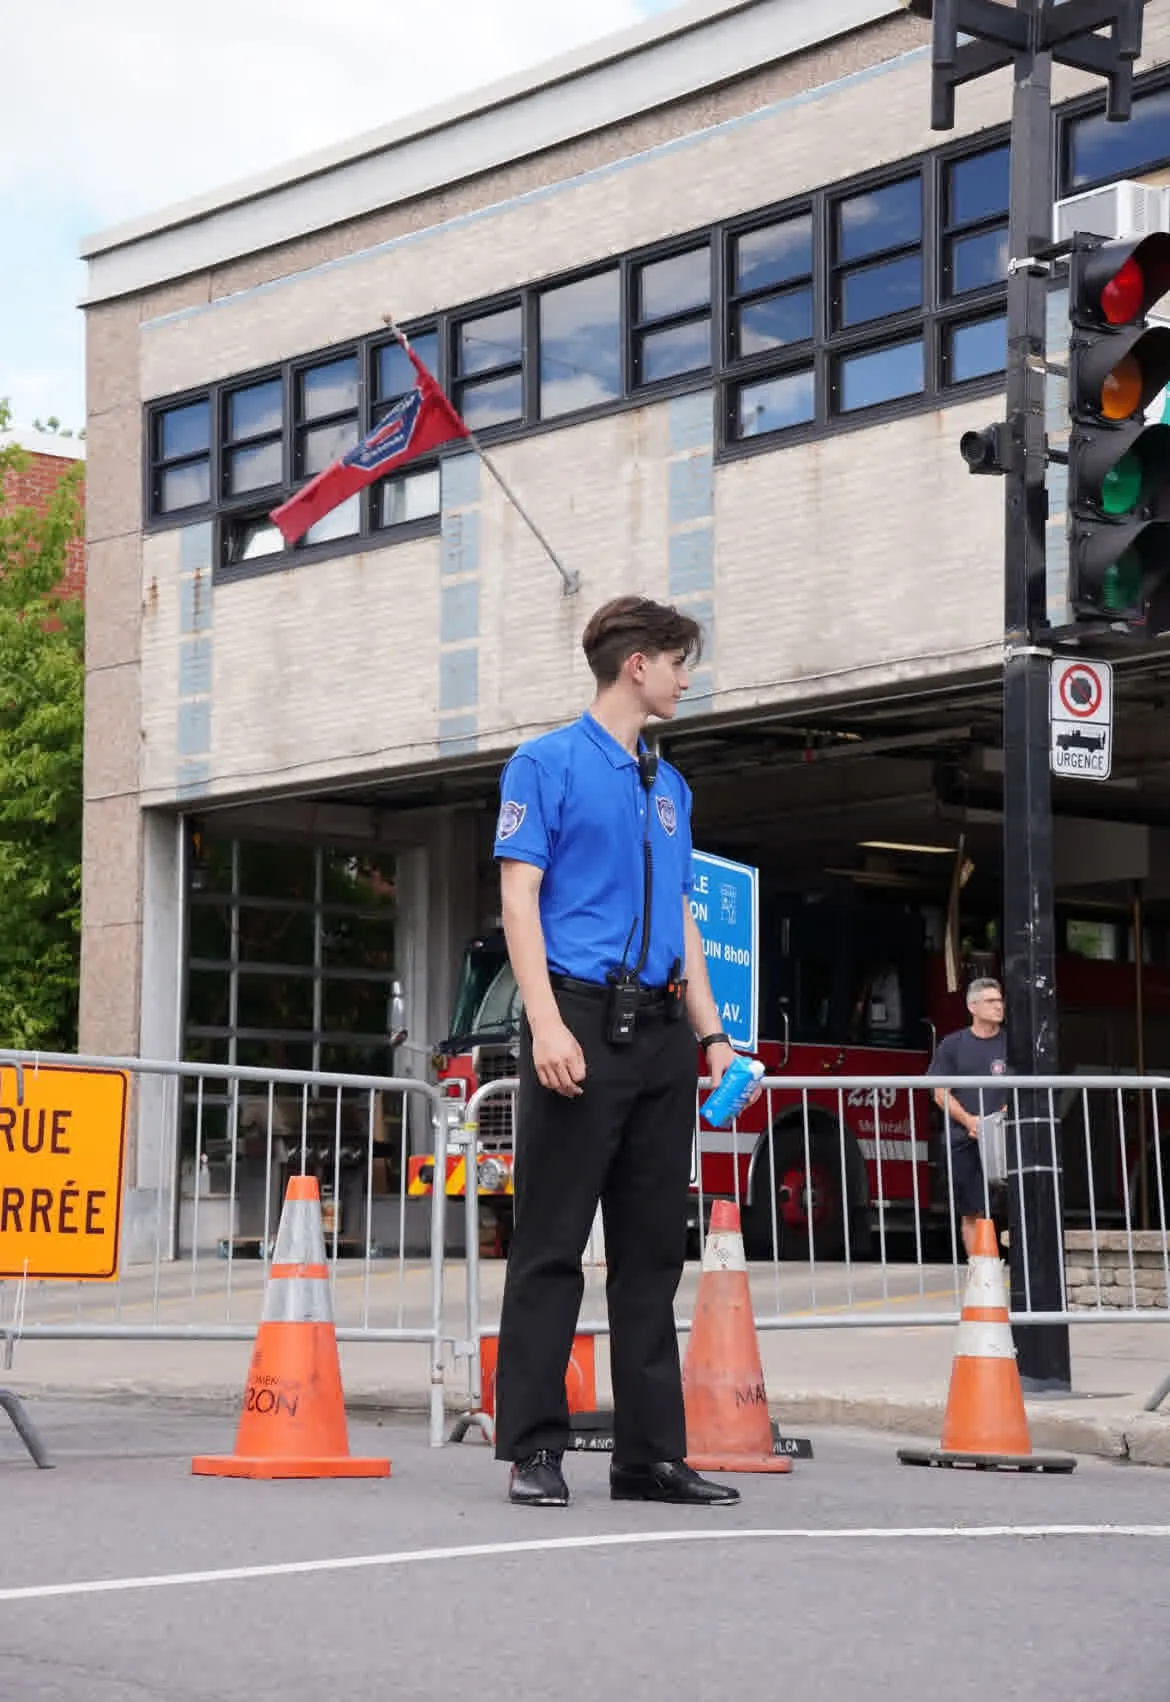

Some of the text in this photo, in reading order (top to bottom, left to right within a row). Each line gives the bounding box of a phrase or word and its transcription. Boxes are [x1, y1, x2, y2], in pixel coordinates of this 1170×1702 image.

[1056, 751, 1104, 770] URGENCE
[724, 943, 751, 967] 8h00
[722, 1002, 743, 1024] AV.
[0, 1107, 72, 1155] RUE
